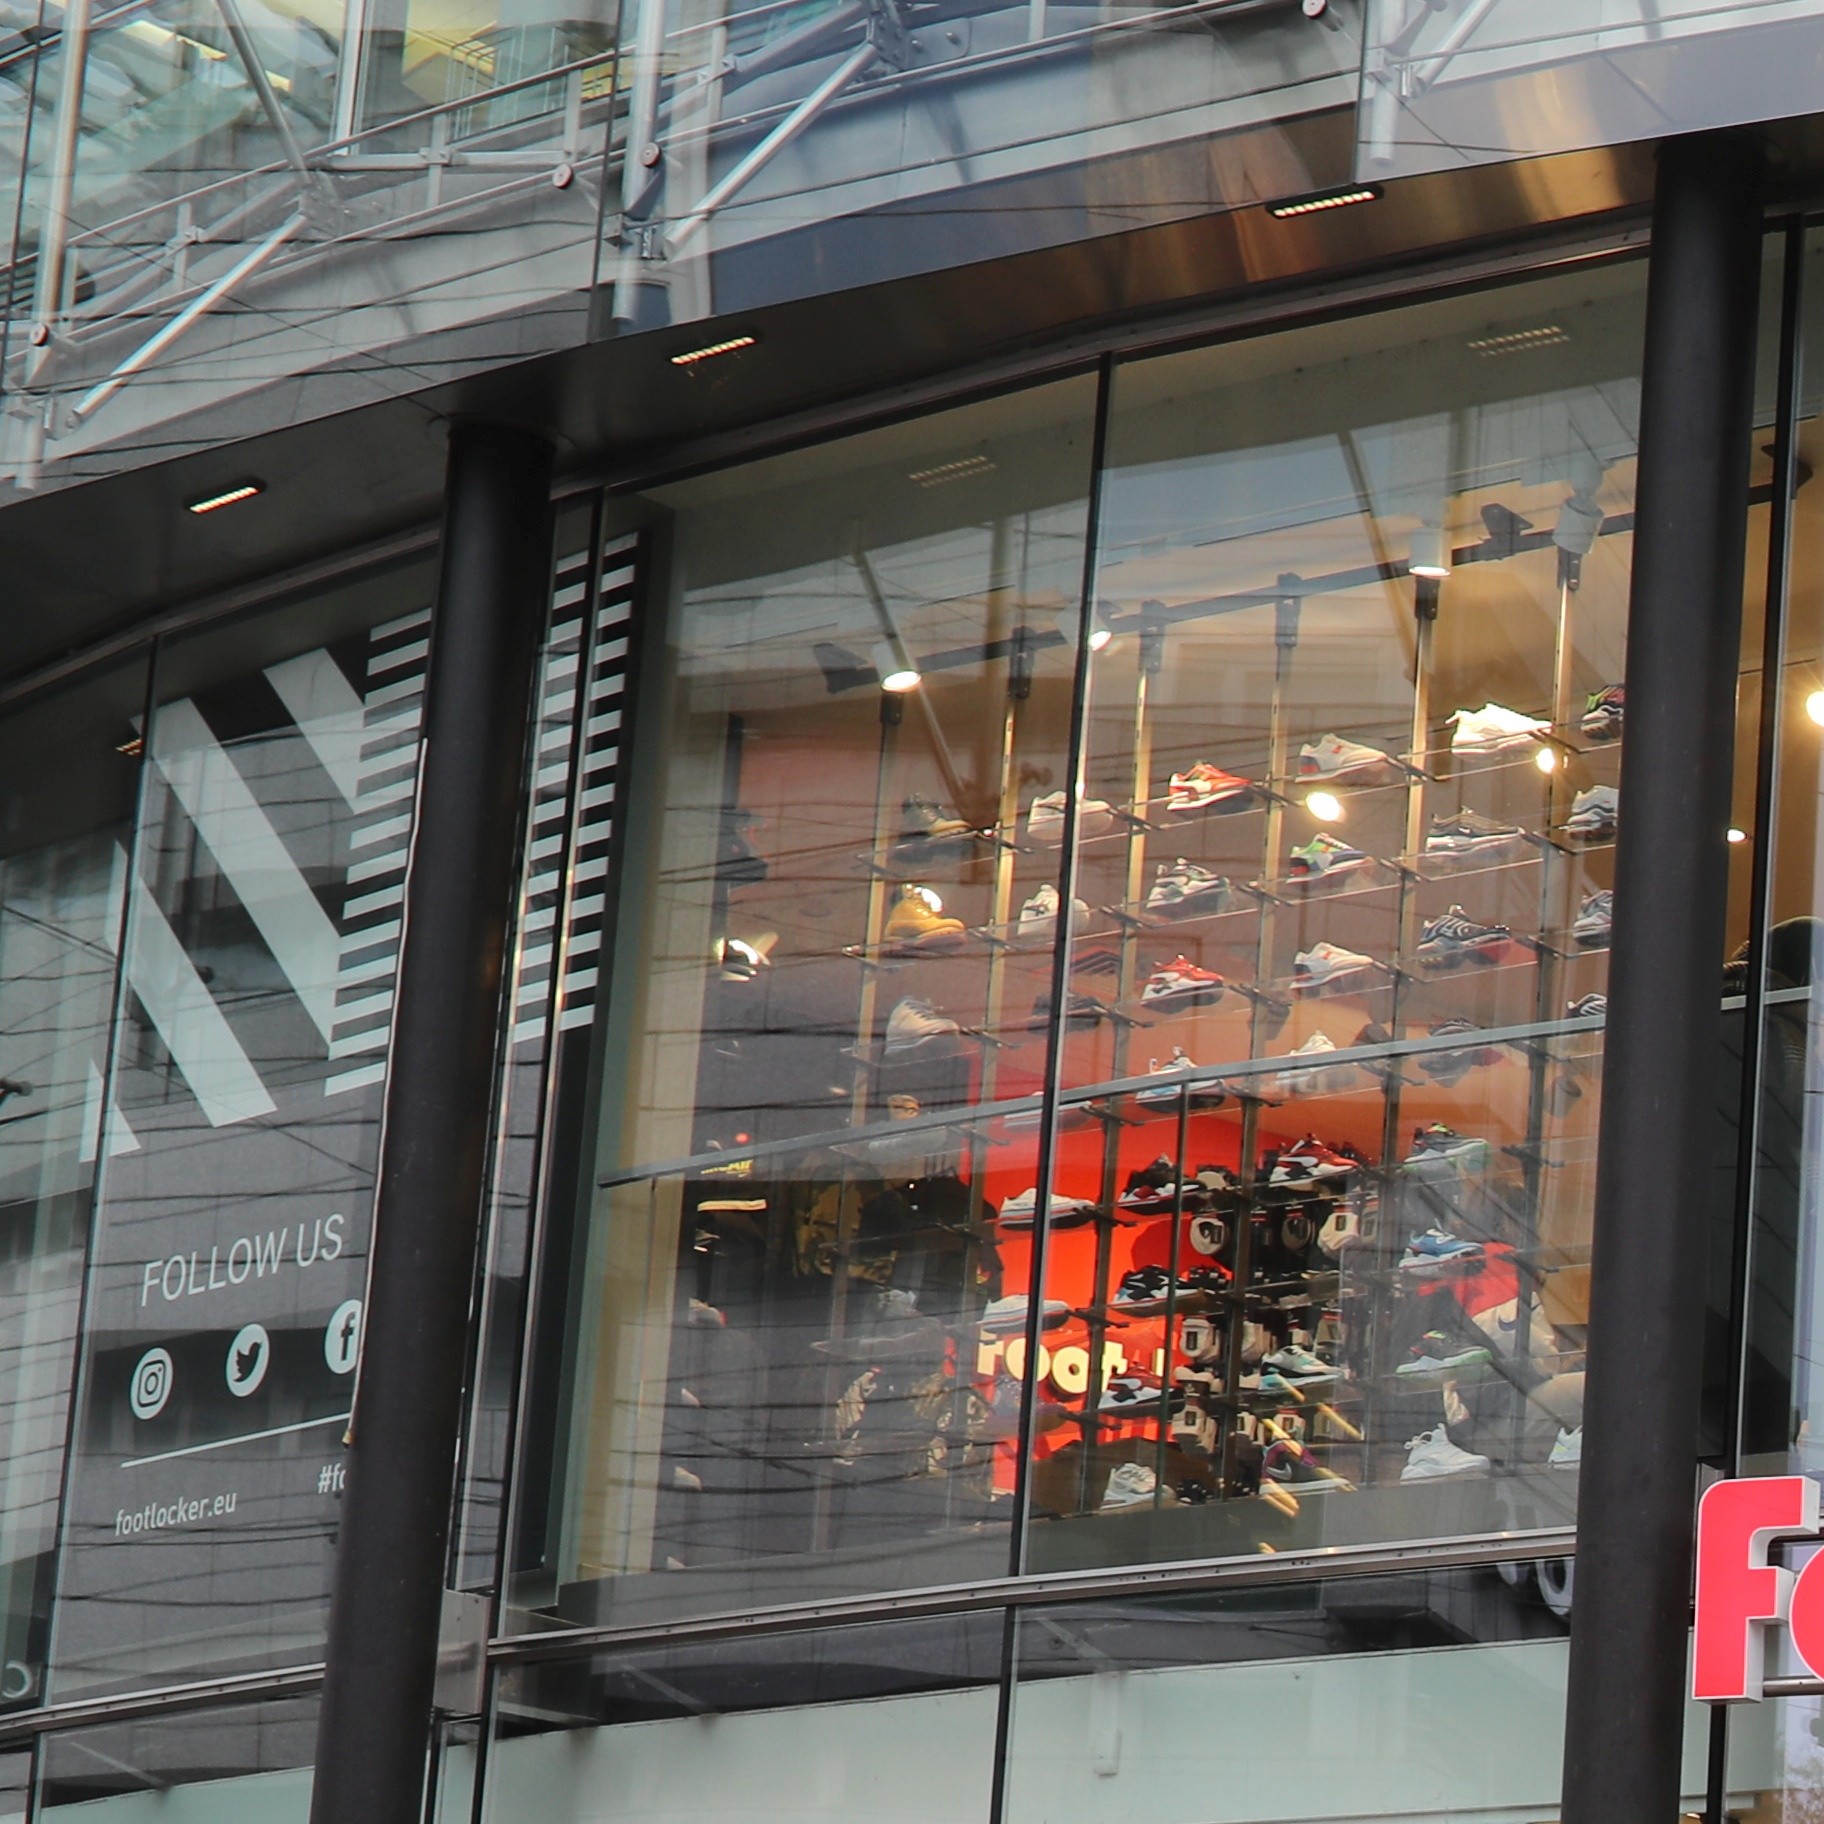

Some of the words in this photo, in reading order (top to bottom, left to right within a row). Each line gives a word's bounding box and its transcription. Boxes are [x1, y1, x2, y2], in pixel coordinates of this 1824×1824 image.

[141, 1229, 287, 1306] FOLLOW
[298, 1214, 345, 1268] US
[115, 1491, 237, 1537] footlocker.eu
